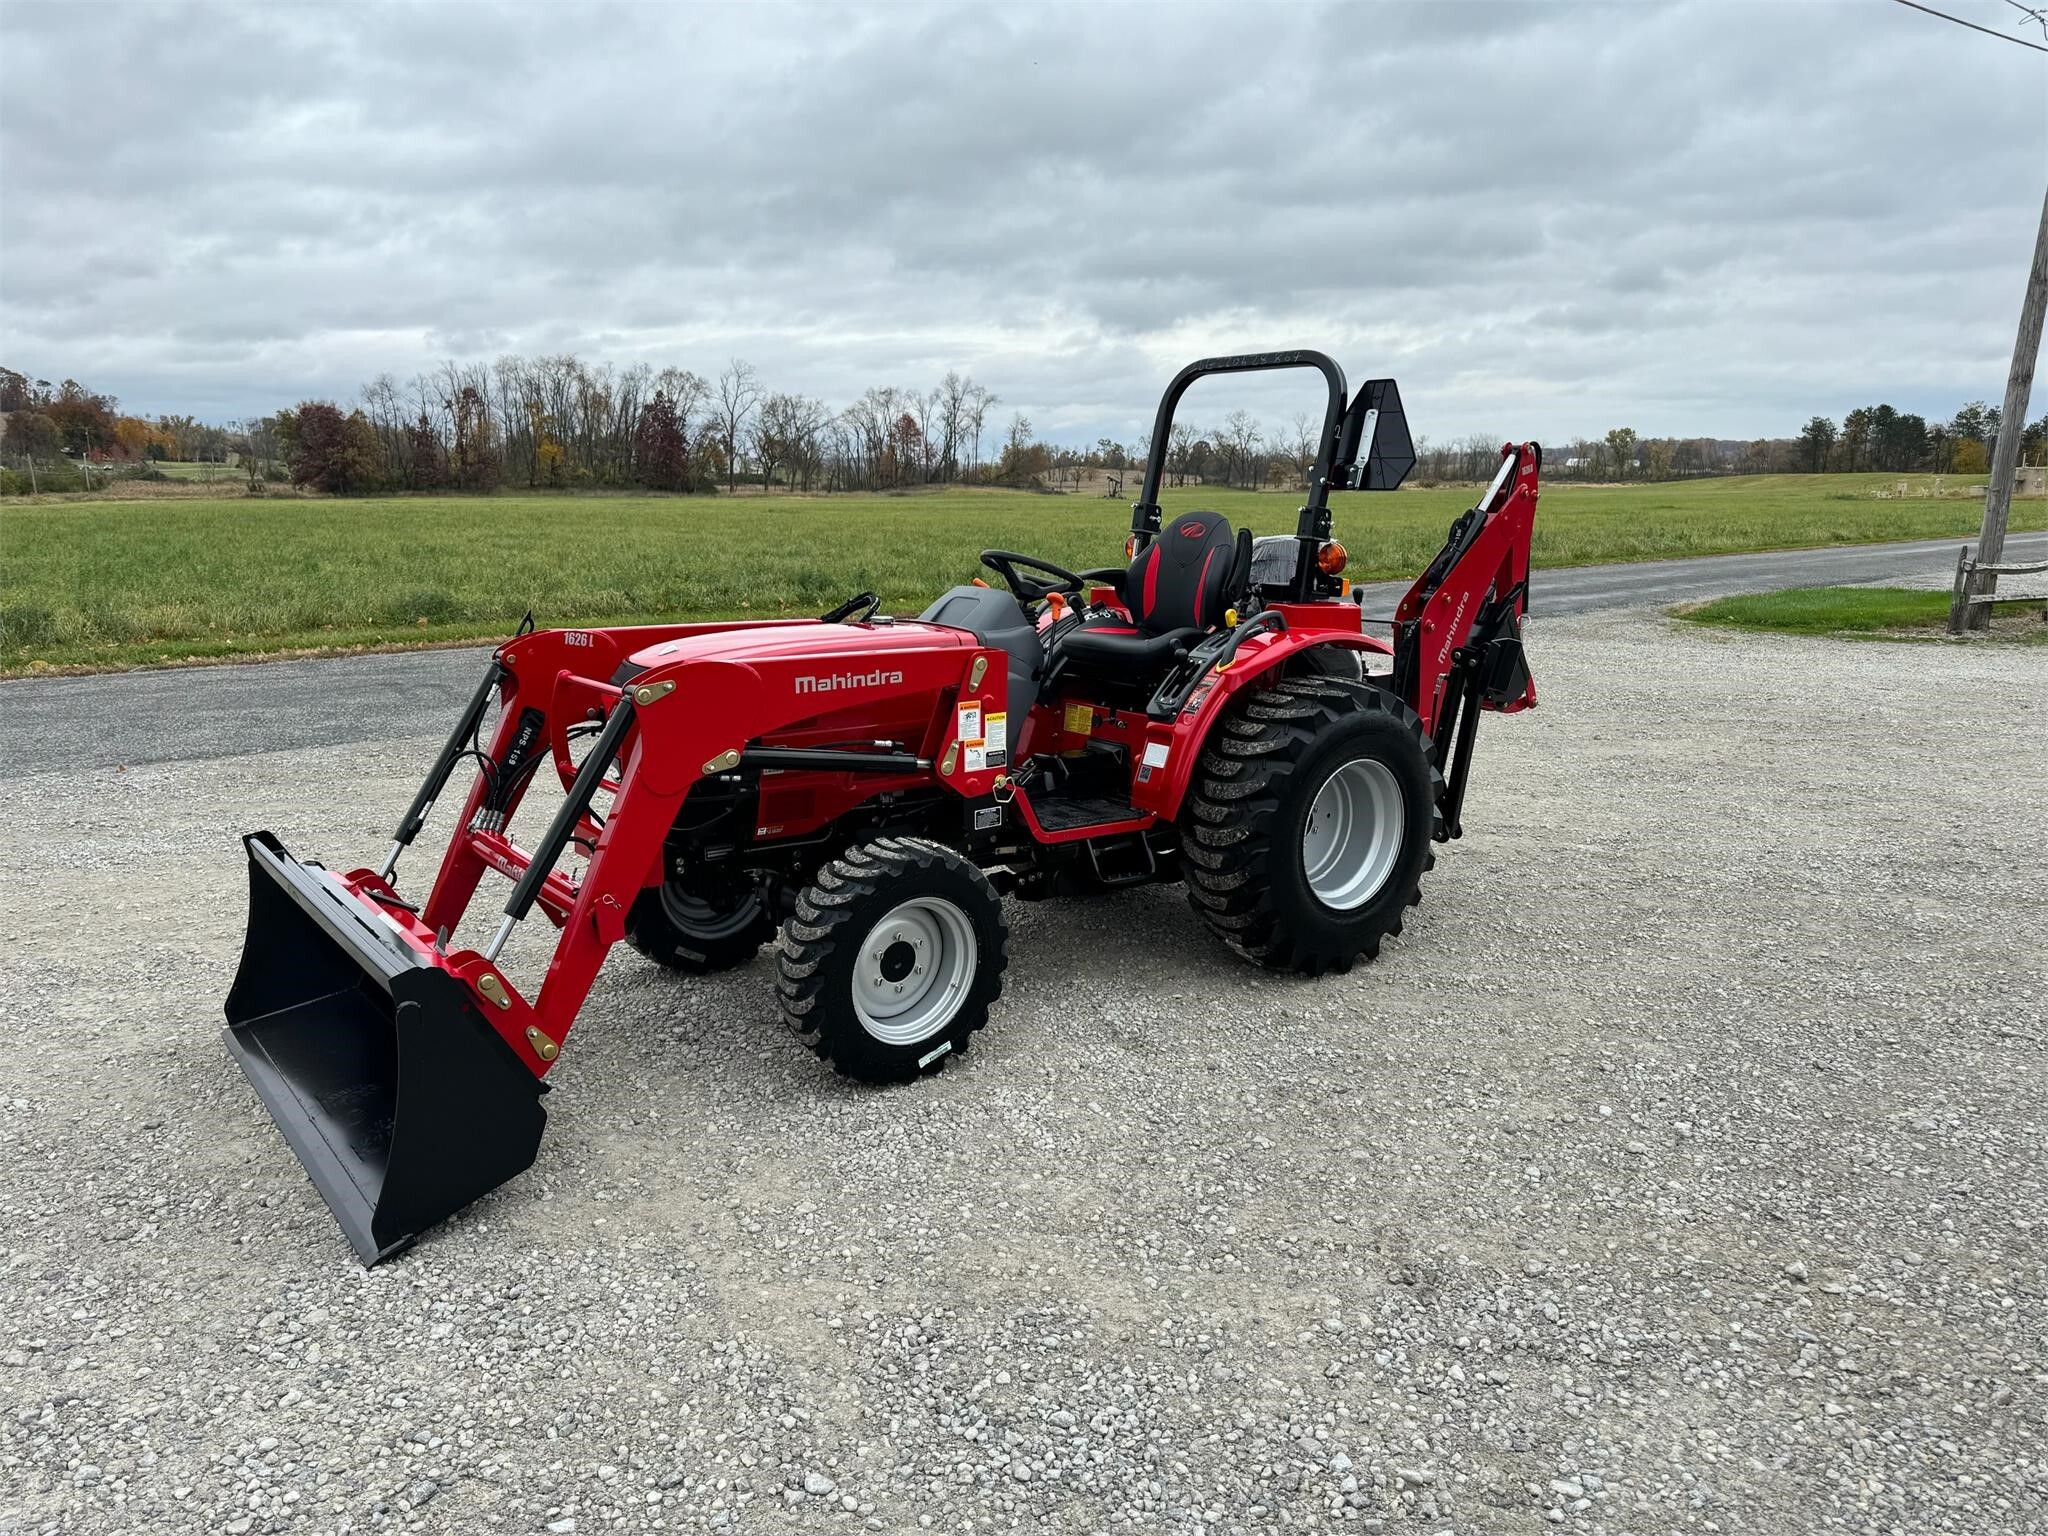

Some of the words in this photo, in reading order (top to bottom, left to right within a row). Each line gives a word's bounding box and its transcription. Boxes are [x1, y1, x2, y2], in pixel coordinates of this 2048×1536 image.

[564, 631, 588, 647] 1626
[588, 633, 594, 648] L
[1438, 591, 1469, 664] Mahindra
[795, 669, 902, 694] Mahindra
